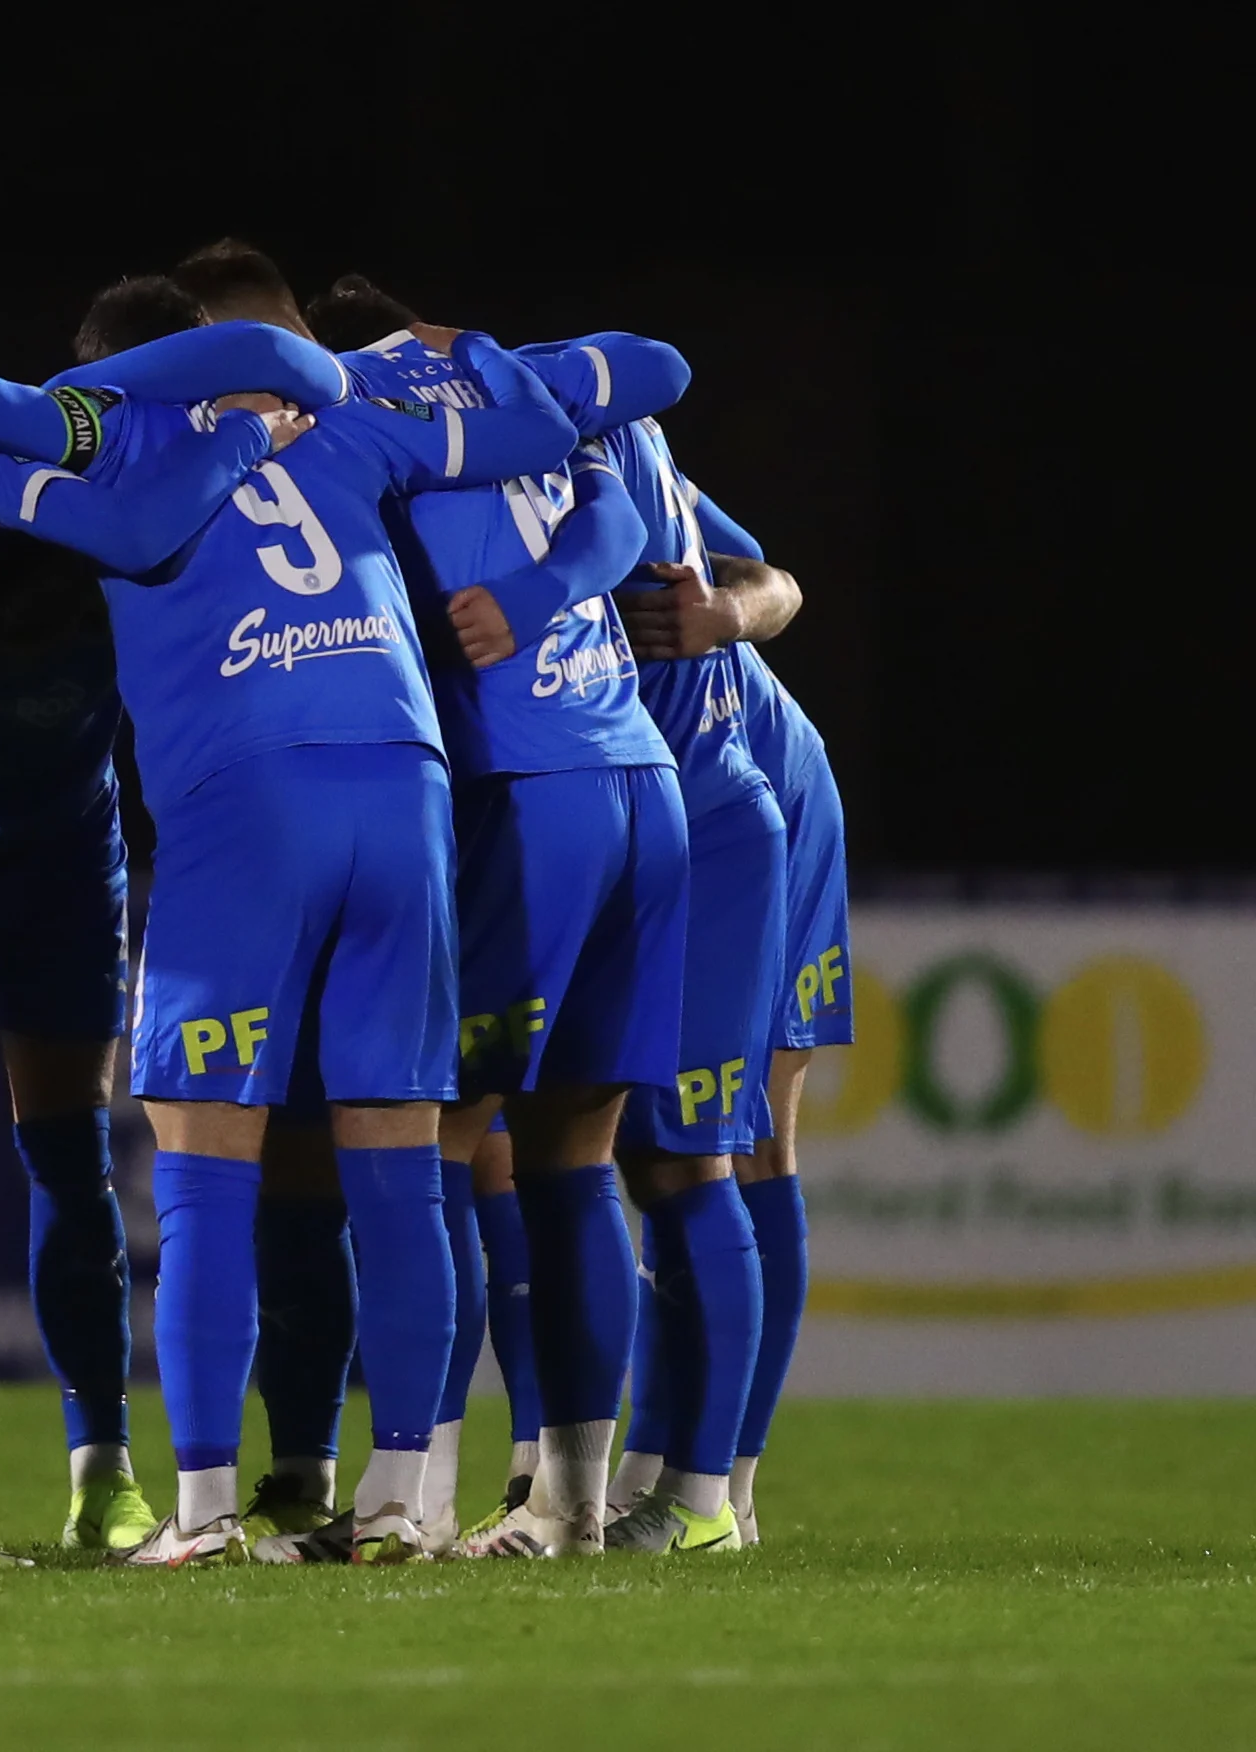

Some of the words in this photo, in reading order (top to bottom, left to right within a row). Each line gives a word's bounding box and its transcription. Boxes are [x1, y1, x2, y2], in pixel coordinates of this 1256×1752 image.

[232, 460, 343, 596] 9
[796, 945, 844, 1022] PF
[179, 1006, 269, 1075] PF
[676, 1057, 745, 1126] PF
